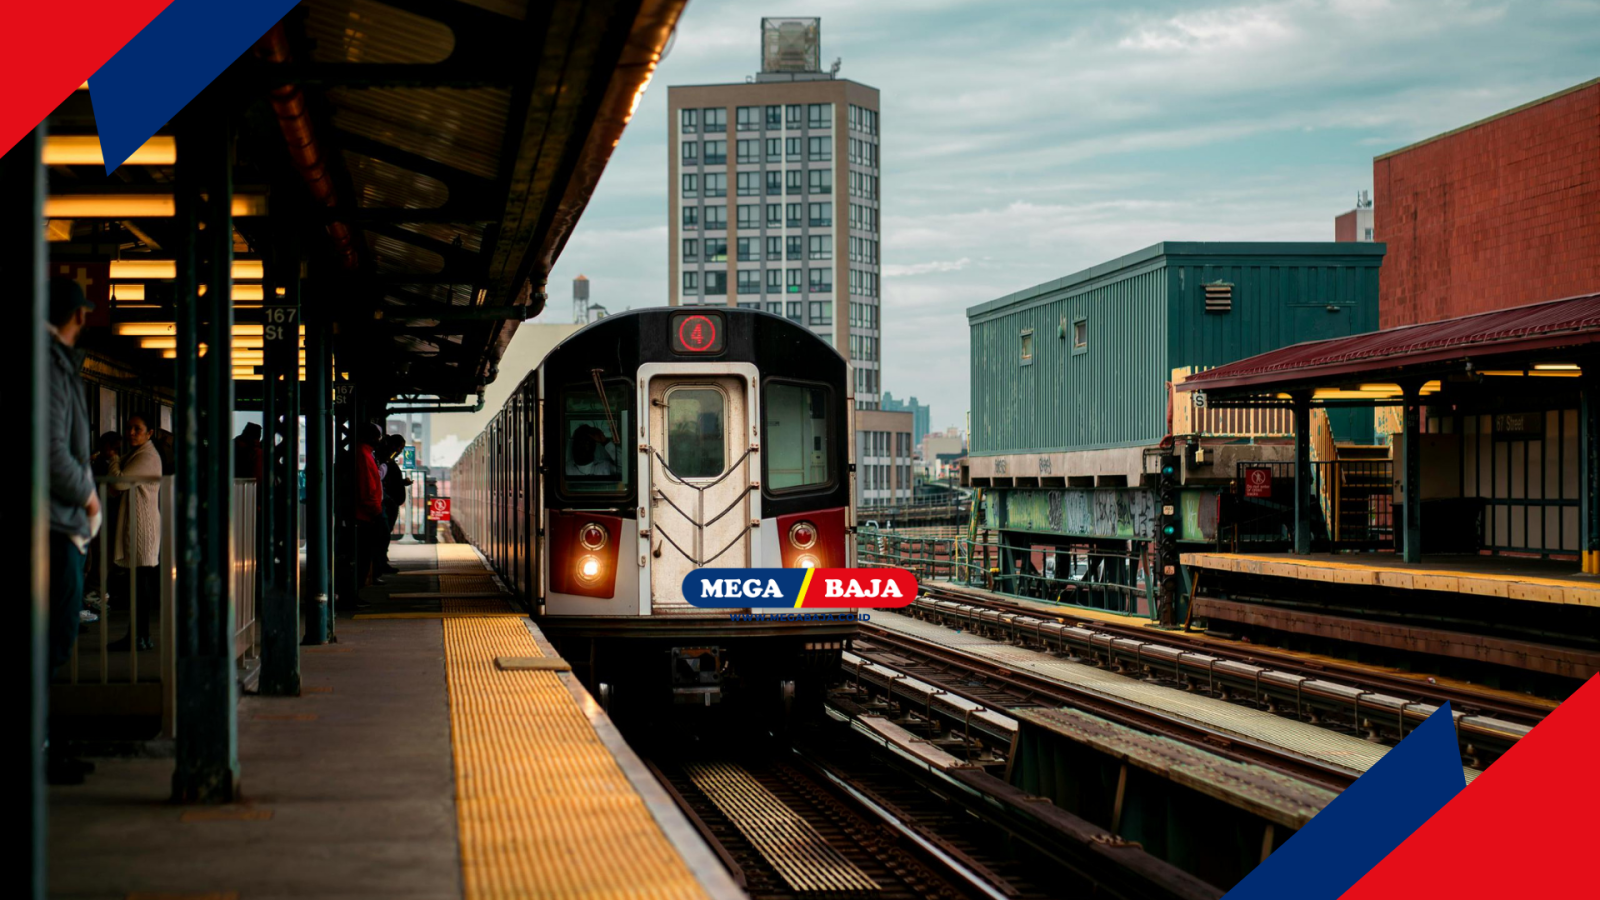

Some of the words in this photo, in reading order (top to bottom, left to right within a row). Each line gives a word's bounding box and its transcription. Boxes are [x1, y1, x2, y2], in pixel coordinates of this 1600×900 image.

[264, 307, 297, 324] 167
[264, 324, 284, 341] St
[690, 323, 704, 345] 4
[335, 385, 355, 395] 167
[336, 395, 347, 405] St
[1195, 395, 1205, 407] S
[1505, 415, 1524, 432] Street
